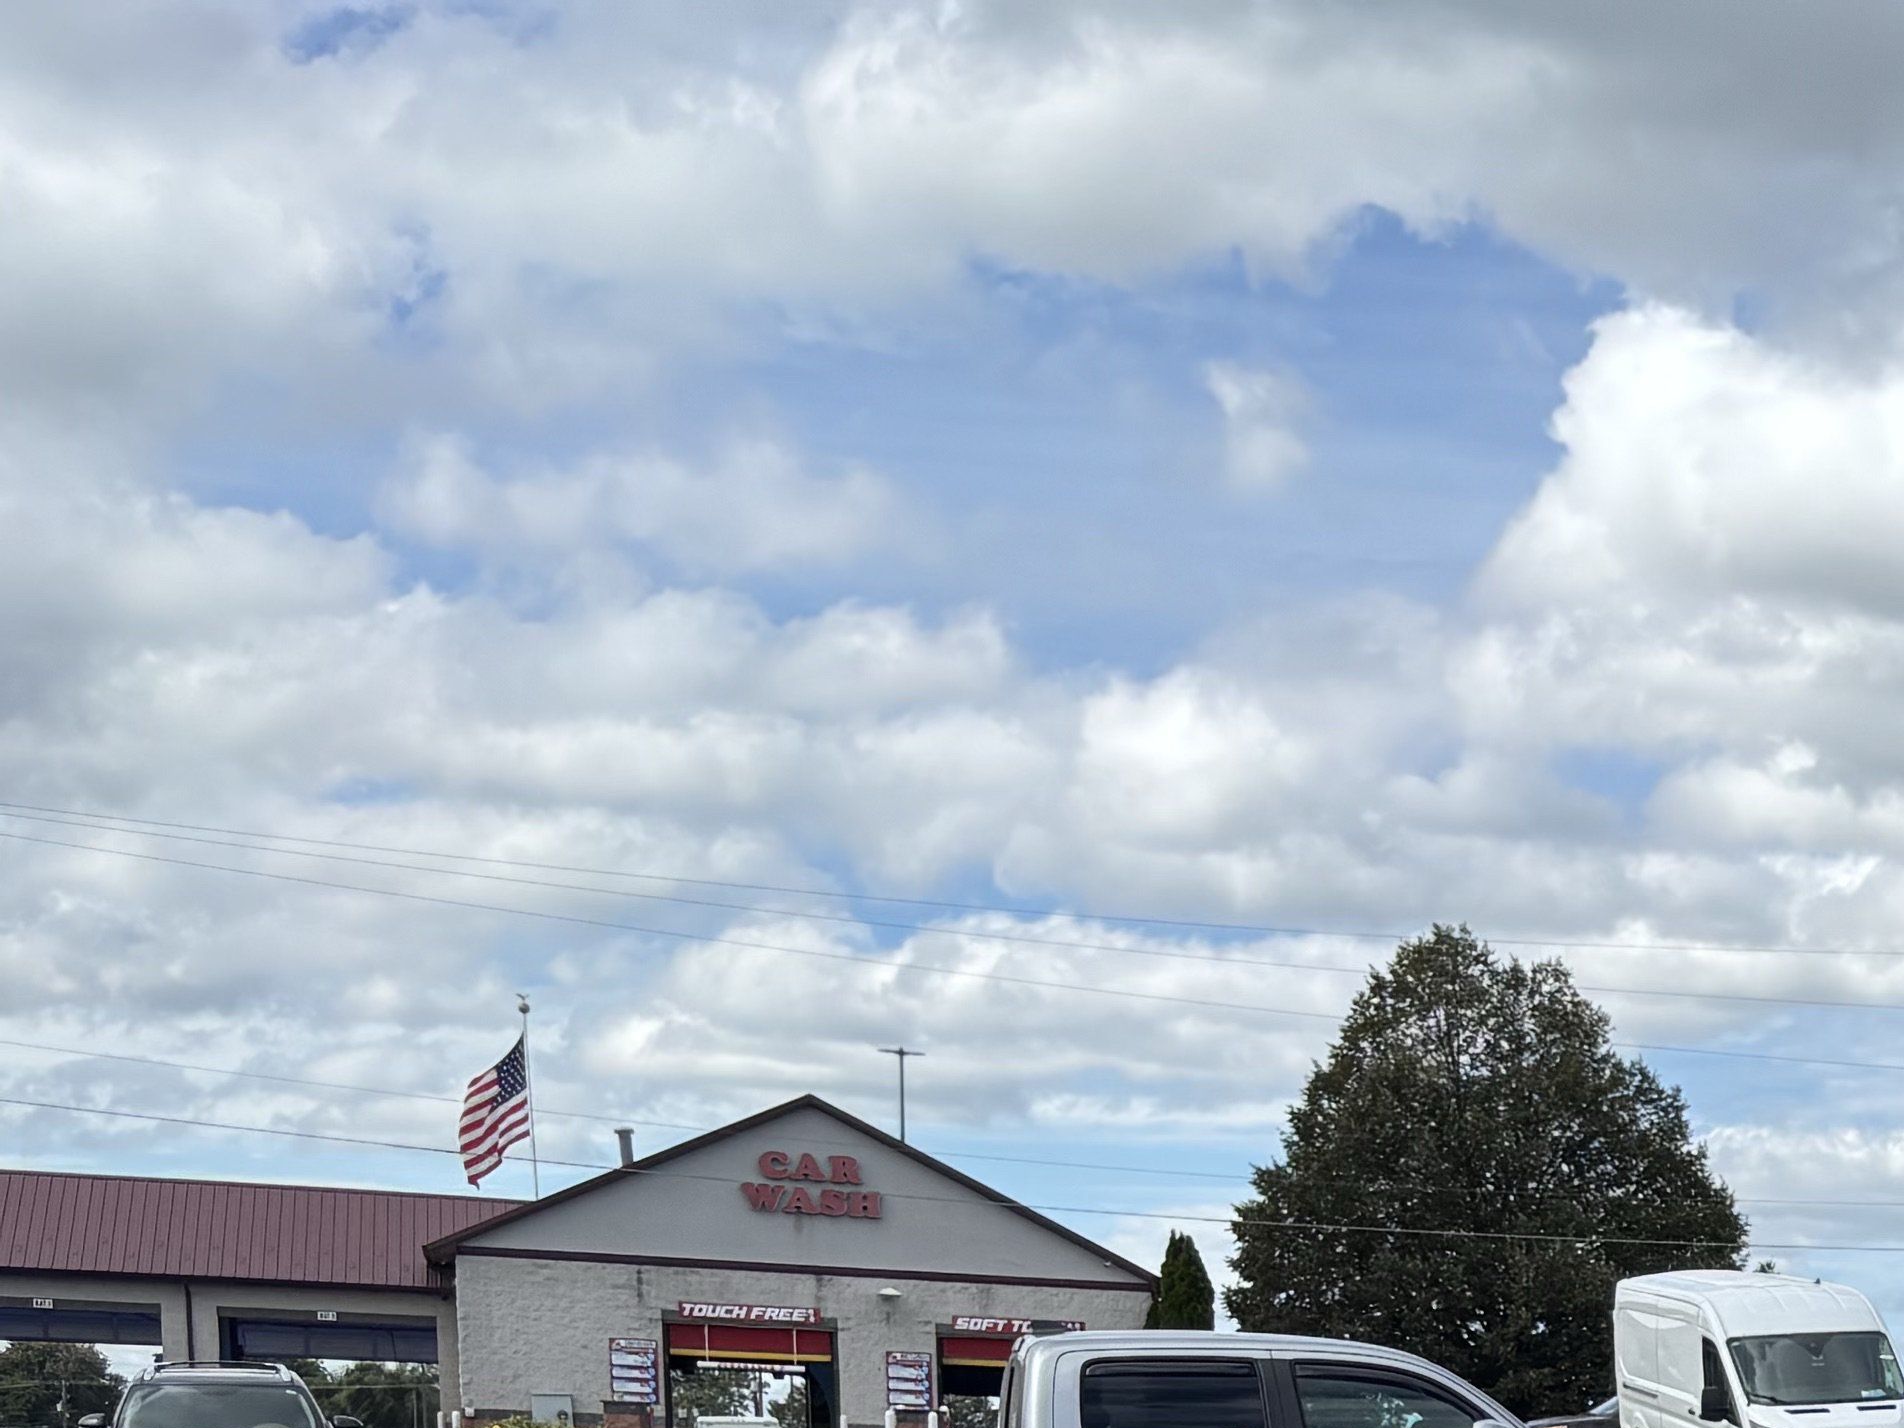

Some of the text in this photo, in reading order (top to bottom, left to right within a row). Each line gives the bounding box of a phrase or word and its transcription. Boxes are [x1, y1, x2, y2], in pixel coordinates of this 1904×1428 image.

[758, 1150, 862, 1184] CAR
[740, 1181, 882, 1219] WASH
[682, 1303, 747, 1319] TOUCH
[954, 1317, 1008, 1332] SOFT
